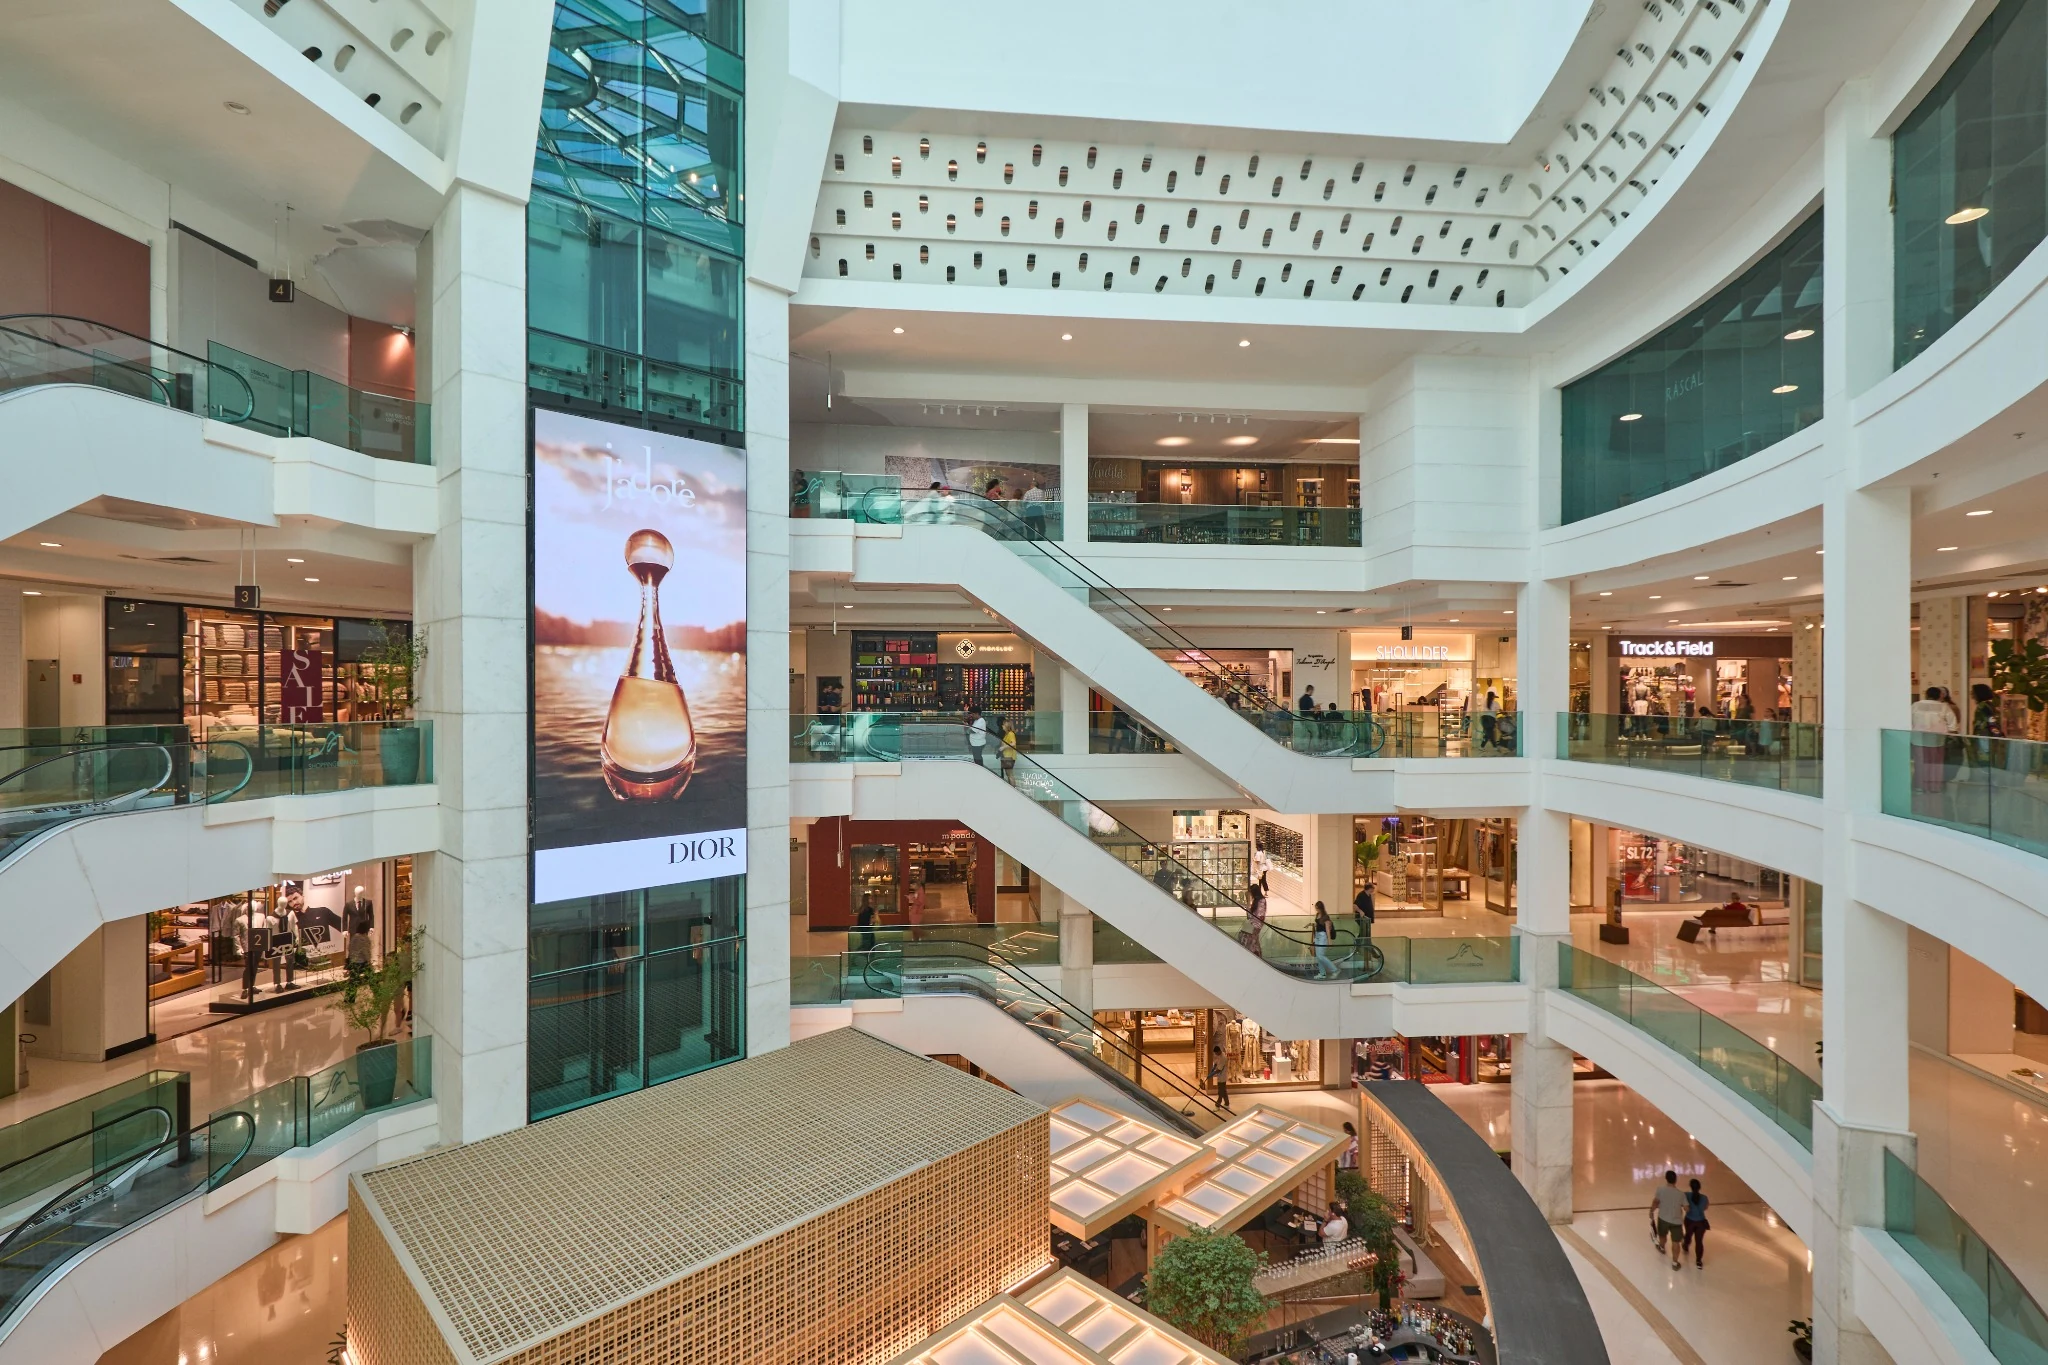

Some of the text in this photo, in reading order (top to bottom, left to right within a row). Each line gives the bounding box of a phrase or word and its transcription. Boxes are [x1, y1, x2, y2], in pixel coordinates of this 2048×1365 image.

[275, 283, 285, 296] 4
[1665, 371, 1705, 401] RASCAL
[241, 591, 249, 603] 3
[1376, 645, 1449, 660] SHOULDER
[1619, 640, 1714, 656] Track&Field
[282, 649, 323, 725] SALE
[668, 837, 736, 864] DIOR
[254, 934, 263, 946] 2
